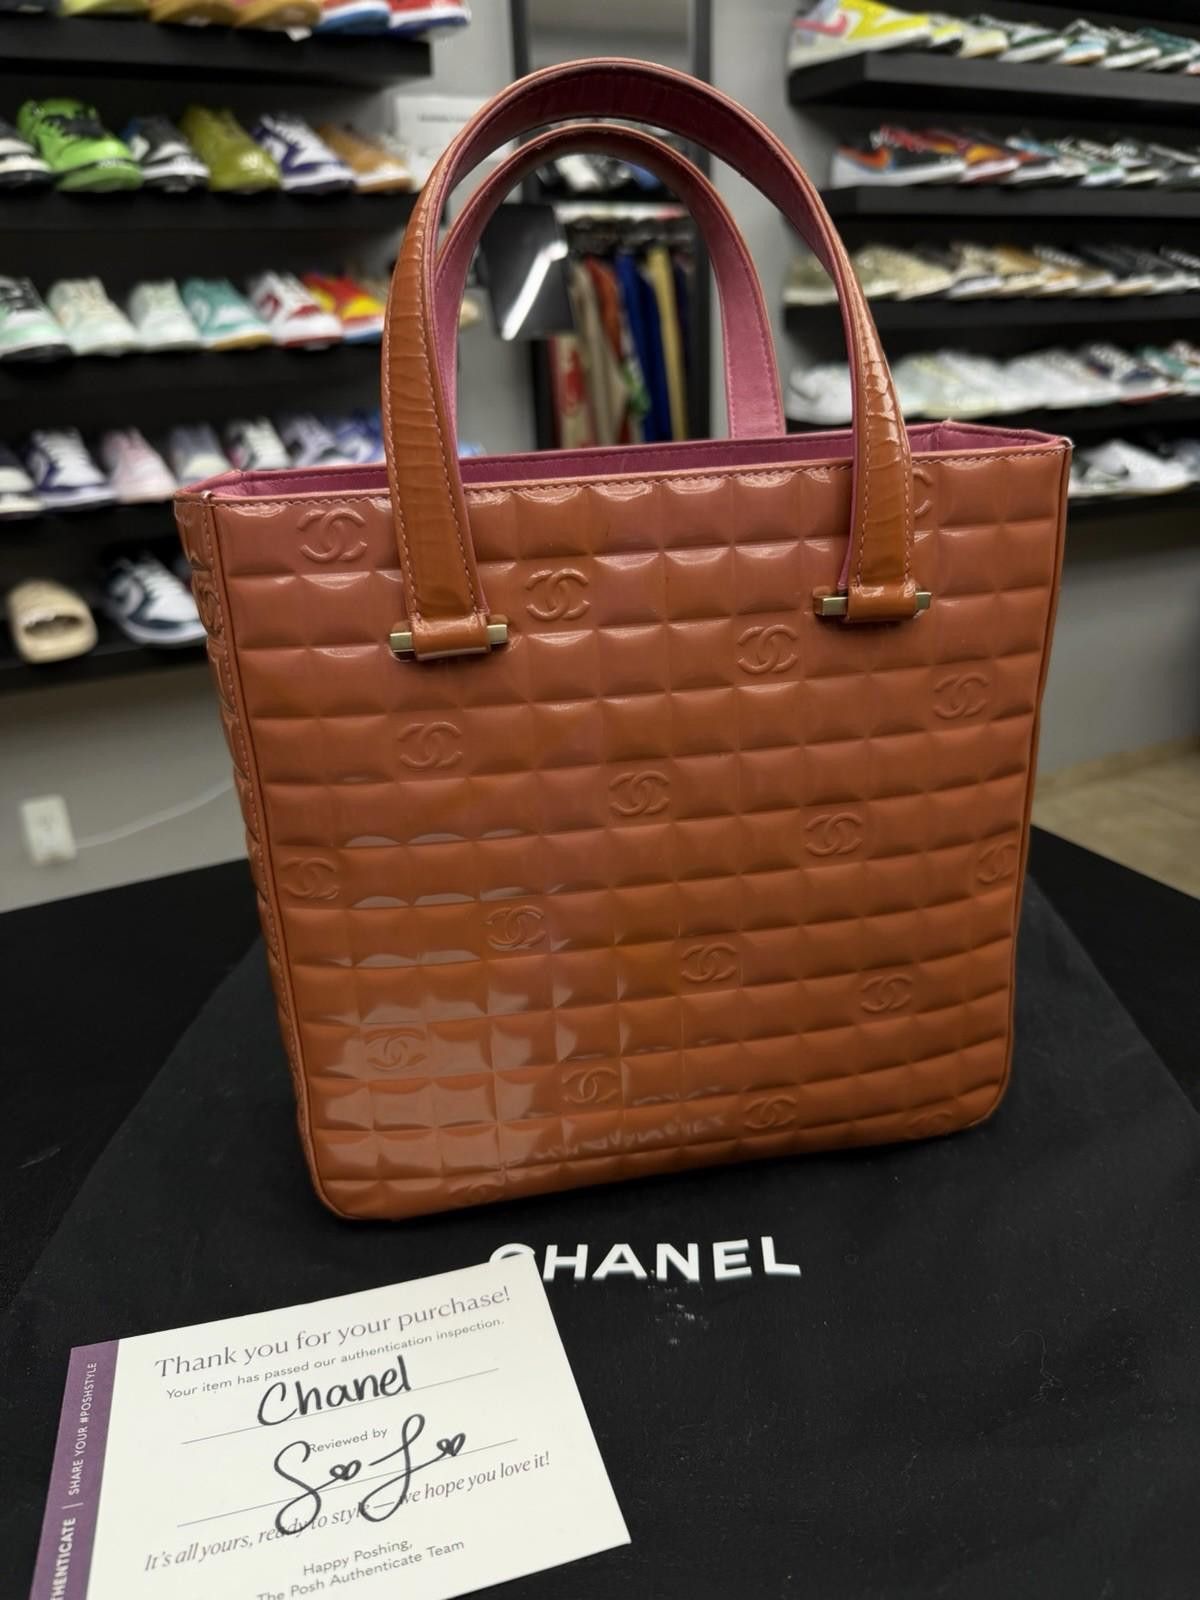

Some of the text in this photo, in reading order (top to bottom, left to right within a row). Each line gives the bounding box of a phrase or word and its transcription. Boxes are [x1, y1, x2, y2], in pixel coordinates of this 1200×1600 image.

[153, 1286, 511, 1378] Thank you for your purchase!
[166, 1318, 505, 1400] Your item has passed our authentication inspection.
[80, 1362, 97, 1424] #POSHSTYLE
[257, 1354, 412, 1426] Chanel
[75, 1425, 88, 1456] YOUR
[309, 1428, 388, 1453] Reviewed by
[68, 1459, 84, 1496] SHARE
[144, 1551, 171, 1572] It's
[175, 1542, 199, 1565] all
[198, 1534, 253, 1563] yours,
[424, 1477, 465, 1499] hope
[467, 1469, 497, 1492] you
[500, 1460, 531, 1479] love
[534, 1451, 550, 1469] it!
[291, 1579, 325, 1597] Posh
[329, 1552, 422, 1586] Authenticate
[426, 1541, 465, 1558] Team
[303, 1540, 413, 1577] Happy Poshing,
